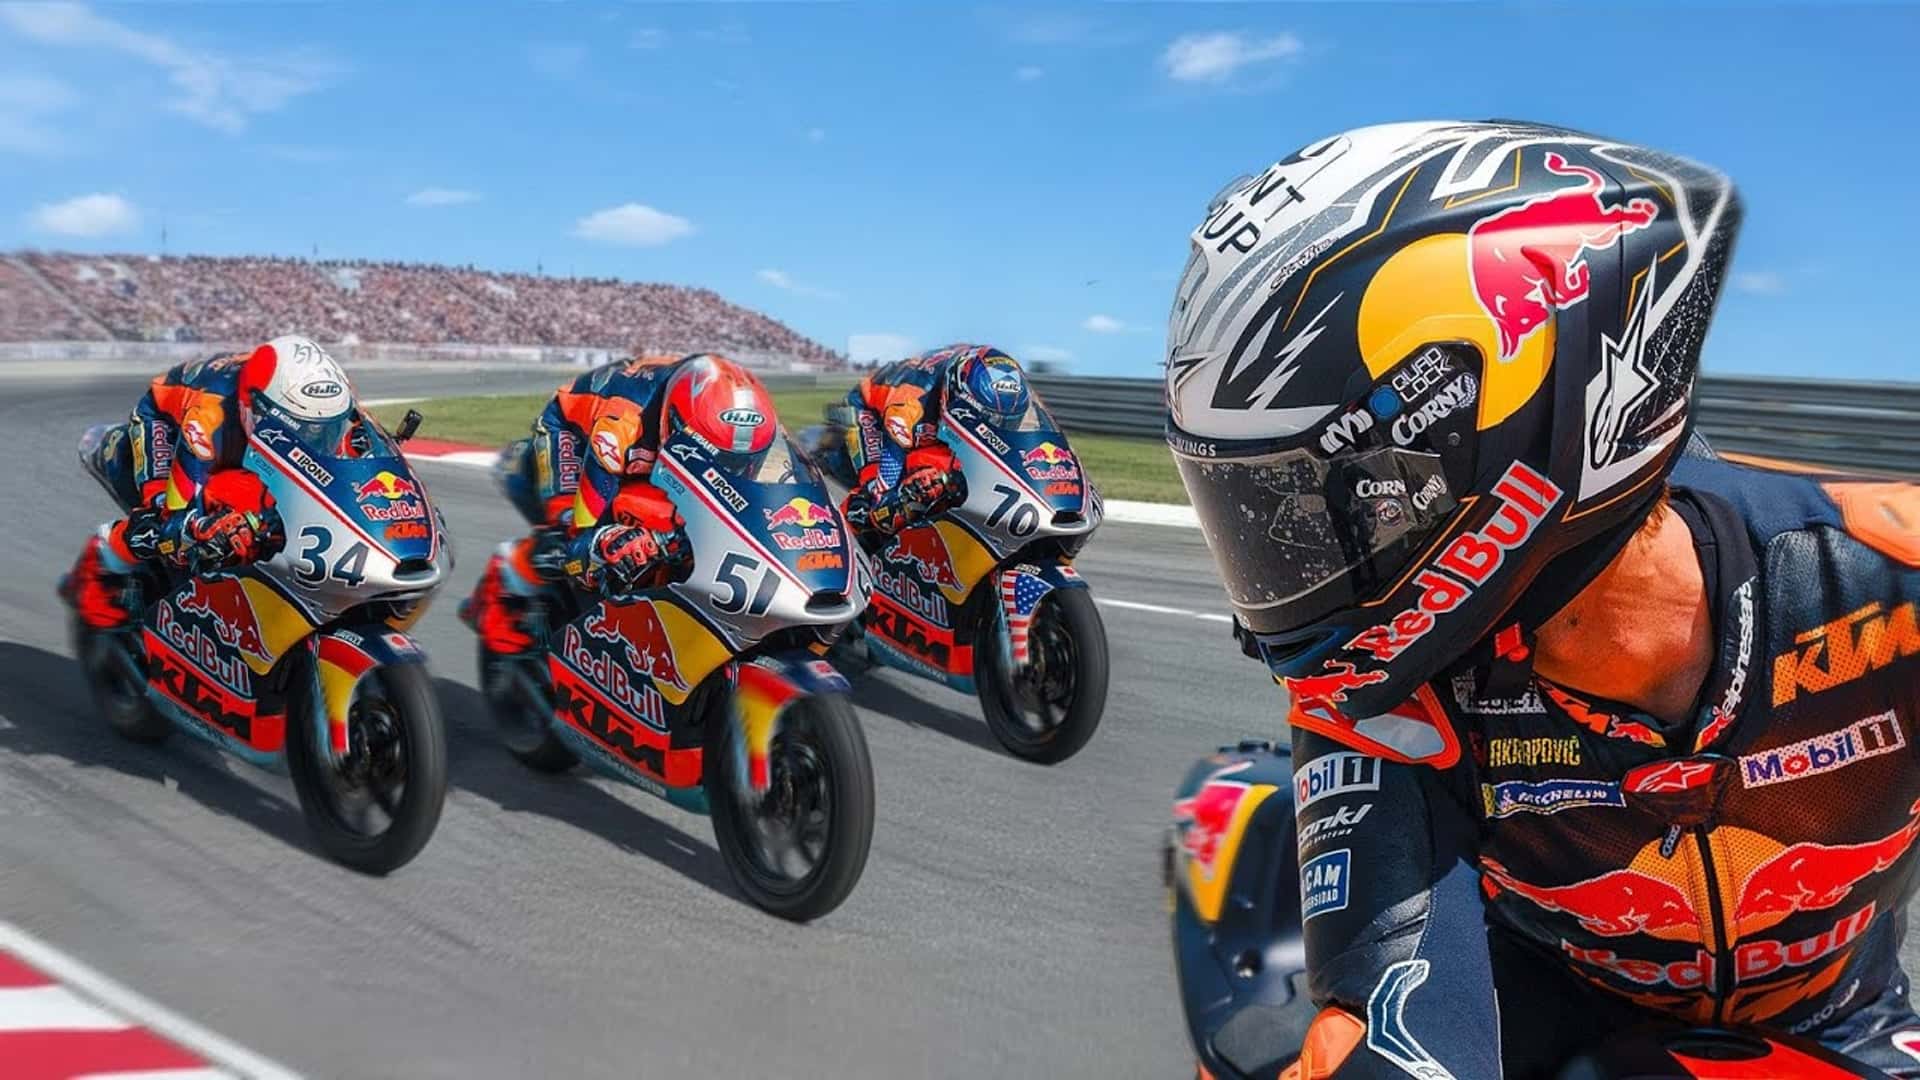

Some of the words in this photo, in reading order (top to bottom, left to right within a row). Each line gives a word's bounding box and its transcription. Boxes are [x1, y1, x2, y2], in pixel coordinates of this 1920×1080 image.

[1391, 346, 1442, 391] QUAD
[1400, 357, 1453, 402] LOCK
[727, 411, 761, 423] HJC
[1391, 374, 1467, 446] CORNY
[296, 454, 332, 486] IPONE
[711, 476, 747, 511] IPONE
[361, 501, 399, 521] Red
[398, 498, 426, 519] Bull
[771, 529, 816, 549] Red
[815, 526, 841, 548] Bull
[985, 482, 1041, 539] 70
[295, 524, 370, 588] 34
[709, 550, 782, 617] 51
[796, 551, 844, 572] KTM
[1342, 568, 1473, 662] Red
[1432, 459, 1565, 587] Bull
[870, 555, 907, 598] Red
[905, 576, 949, 627] Bull
[156, 598, 199, 661] Red
[197, 636, 251, 694] Bull
[866, 602, 949, 671] KTM
[1772, 601, 1920, 708] KTM
[149, 652, 251, 740] KTM
[563, 623, 611, 688] Red
[609, 664, 666, 729] Bull
[552, 684, 667, 778] KTM
[1745, 730, 1856, 783] Mobil
[1298, 758, 1337, 803] obil
[1305, 864, 1342, 892] CAM
[1561, 936, 1718, 993] Red
[1734, 900, 1876, 985] Bull
